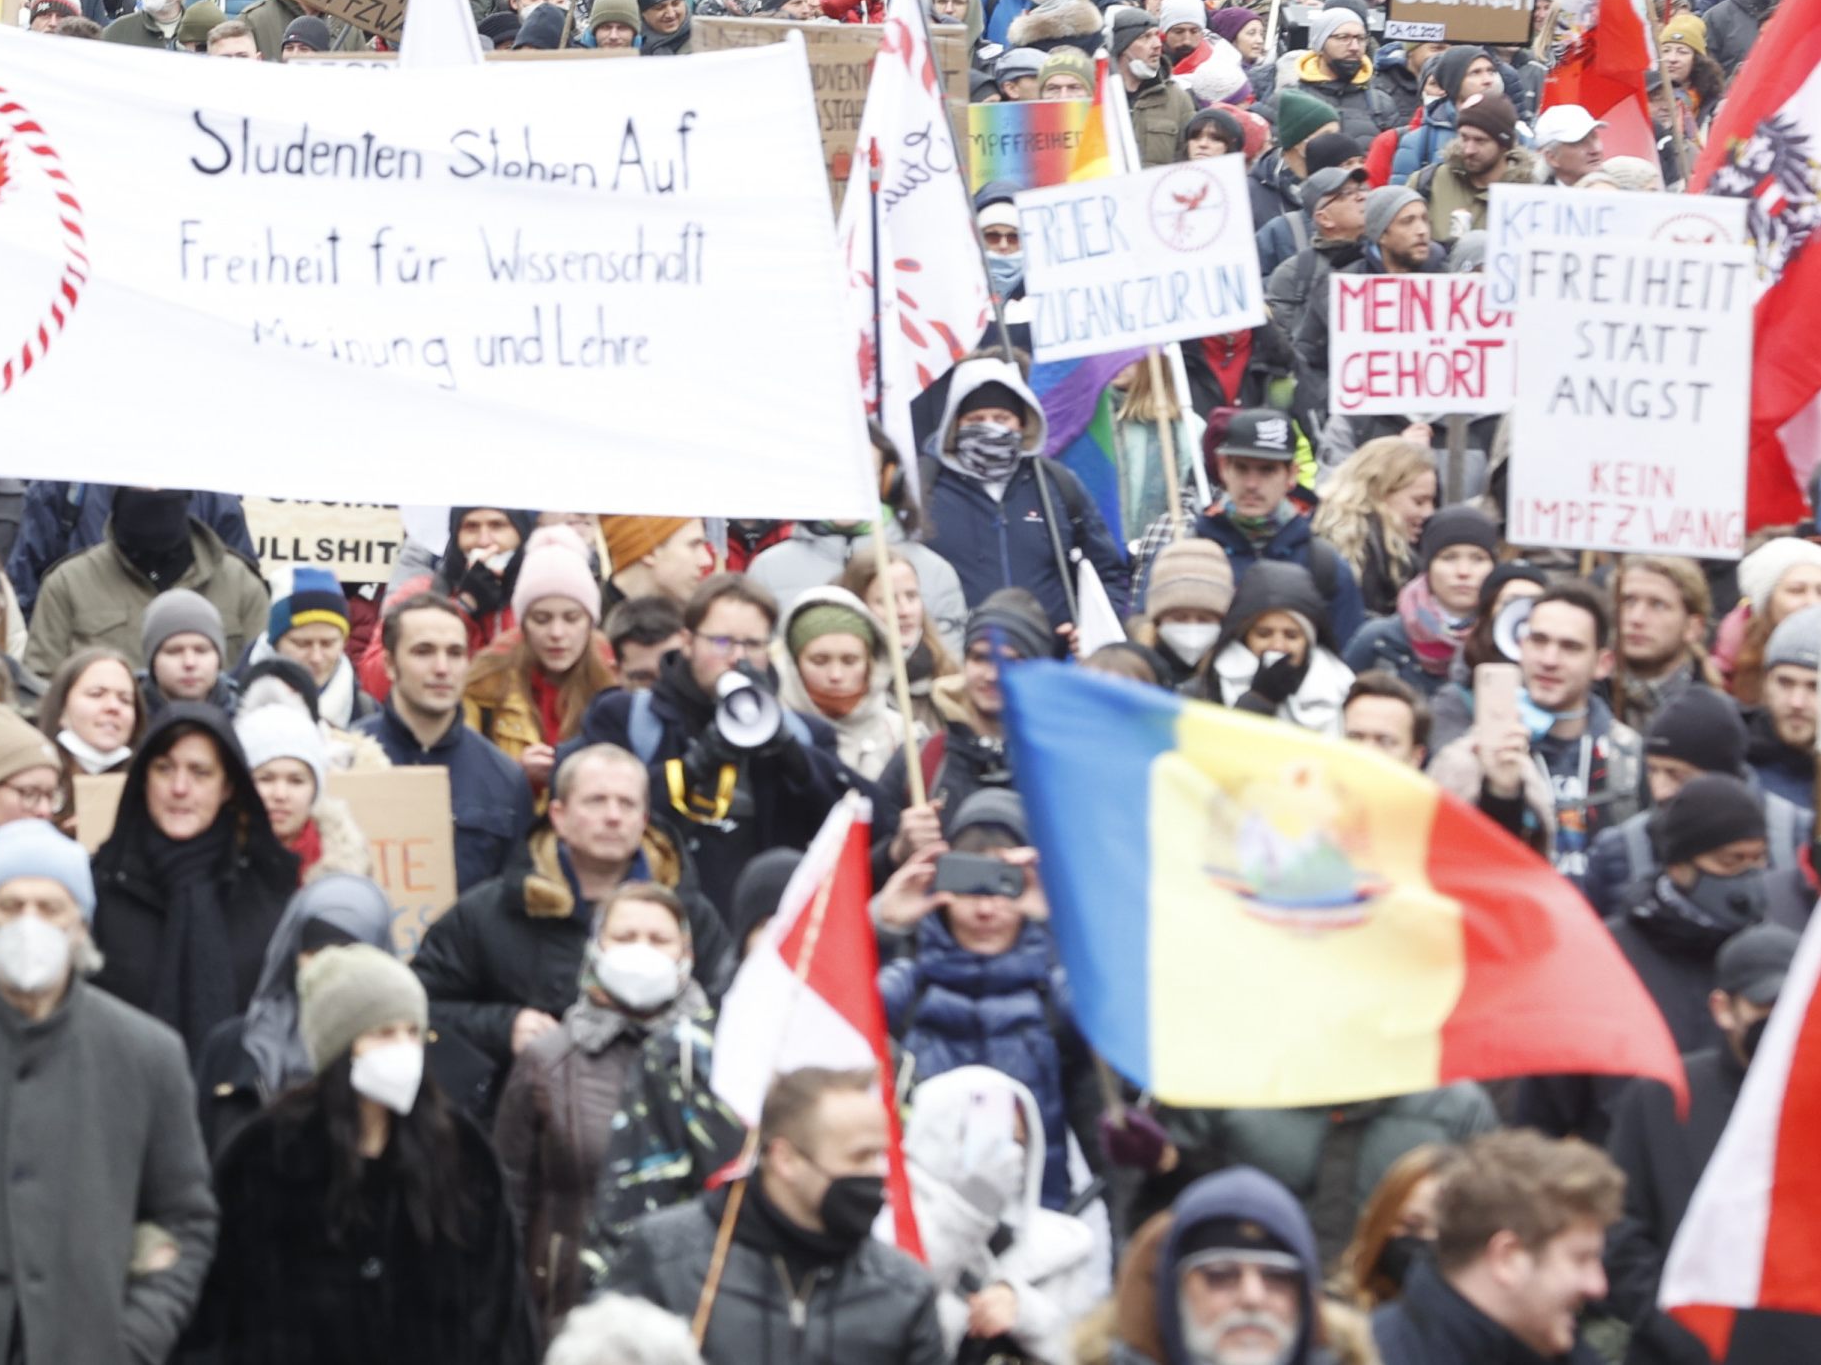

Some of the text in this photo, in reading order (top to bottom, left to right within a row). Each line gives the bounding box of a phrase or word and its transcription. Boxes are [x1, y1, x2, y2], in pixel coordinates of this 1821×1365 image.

[180, 219, 341, 286] Freiheit
[369, 225, 447, 286] für
[1018, 195, 1131, 267] FREIER
[1338, 277, 1433, 334] MEIN
[1529, 249, 1748, 314] FREIHEIT
[475, 304, 544, 367] und
[554, 303, 651, 367] Lehre
[1028, 279, 1137, 350] ZUGANG
[1575, 319, 1711, 367] STATT
[1338, 338, 1505, 409] GEHÖRT
[1546, 374, 1712, 425] ANGST
[1590, 460, 1676, 500] KEIN
